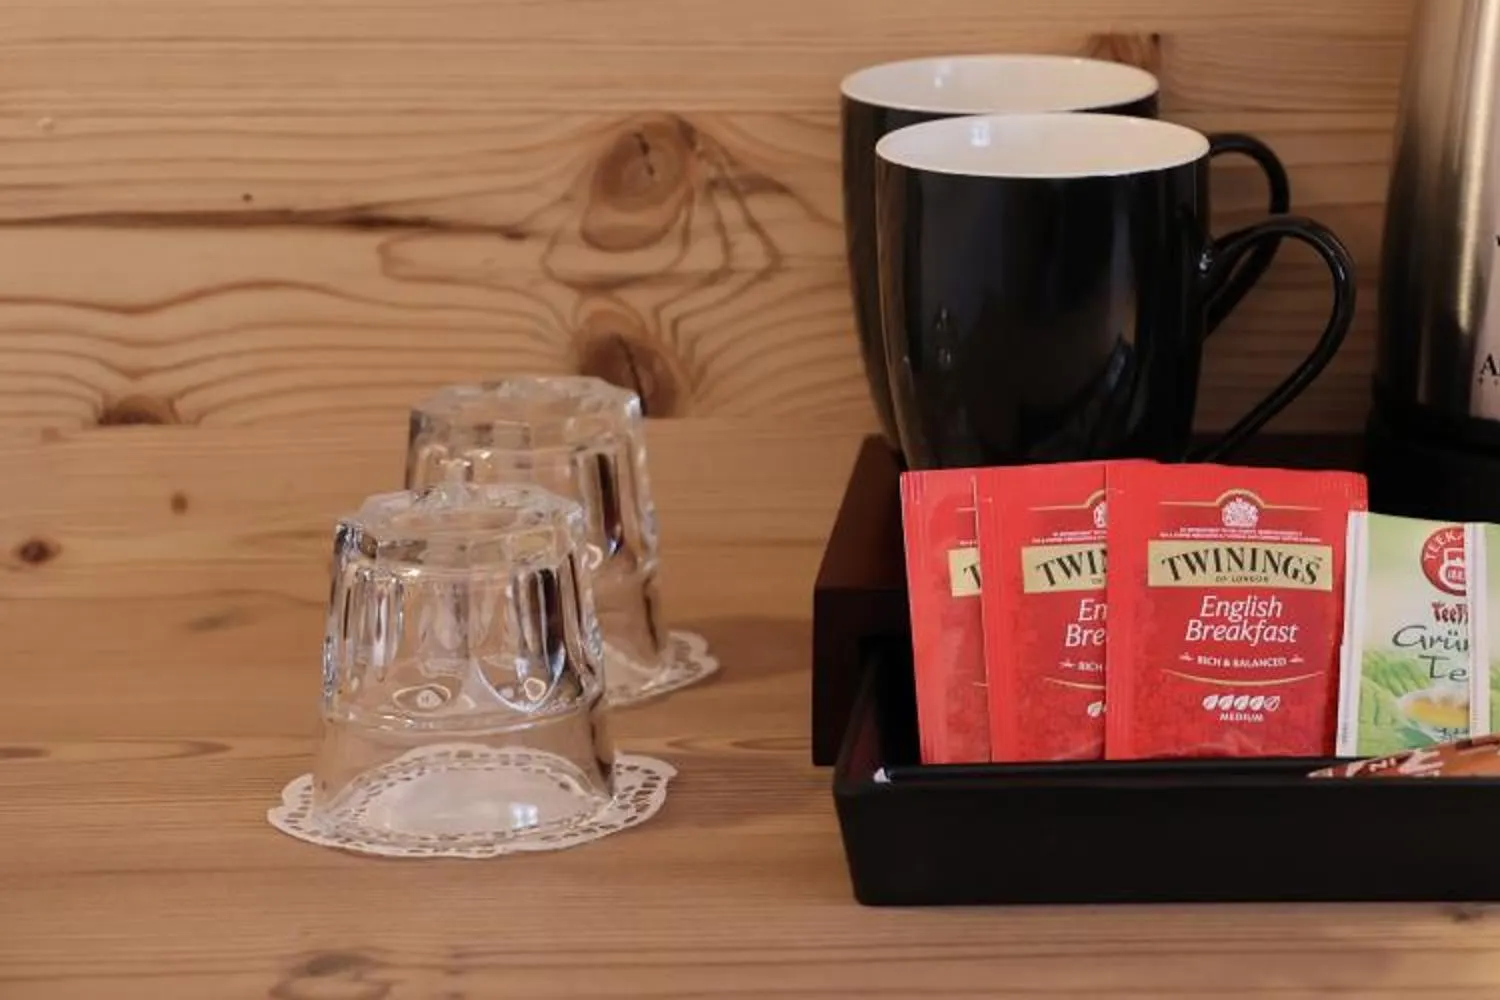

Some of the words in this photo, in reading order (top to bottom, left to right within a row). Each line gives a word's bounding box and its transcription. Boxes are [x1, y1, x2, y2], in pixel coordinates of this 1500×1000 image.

[1036, 549, 1107, 586] TWI
[1161, 547, 1321, 585] TWININGS
[1078, 598, 1107, 622] En
[1200, 595, 1283, 623] English
[1065, 623, 1106, 647] Bre
[1185, 619, 1299, 646] Breakfast
[1197, 656, 1221, 667] RICH
[1233, 658, 1288, 668] BALANCED
[1418, 655, 1468, 682] Te
[1220, 713, 1264, 722] MEDIUM
